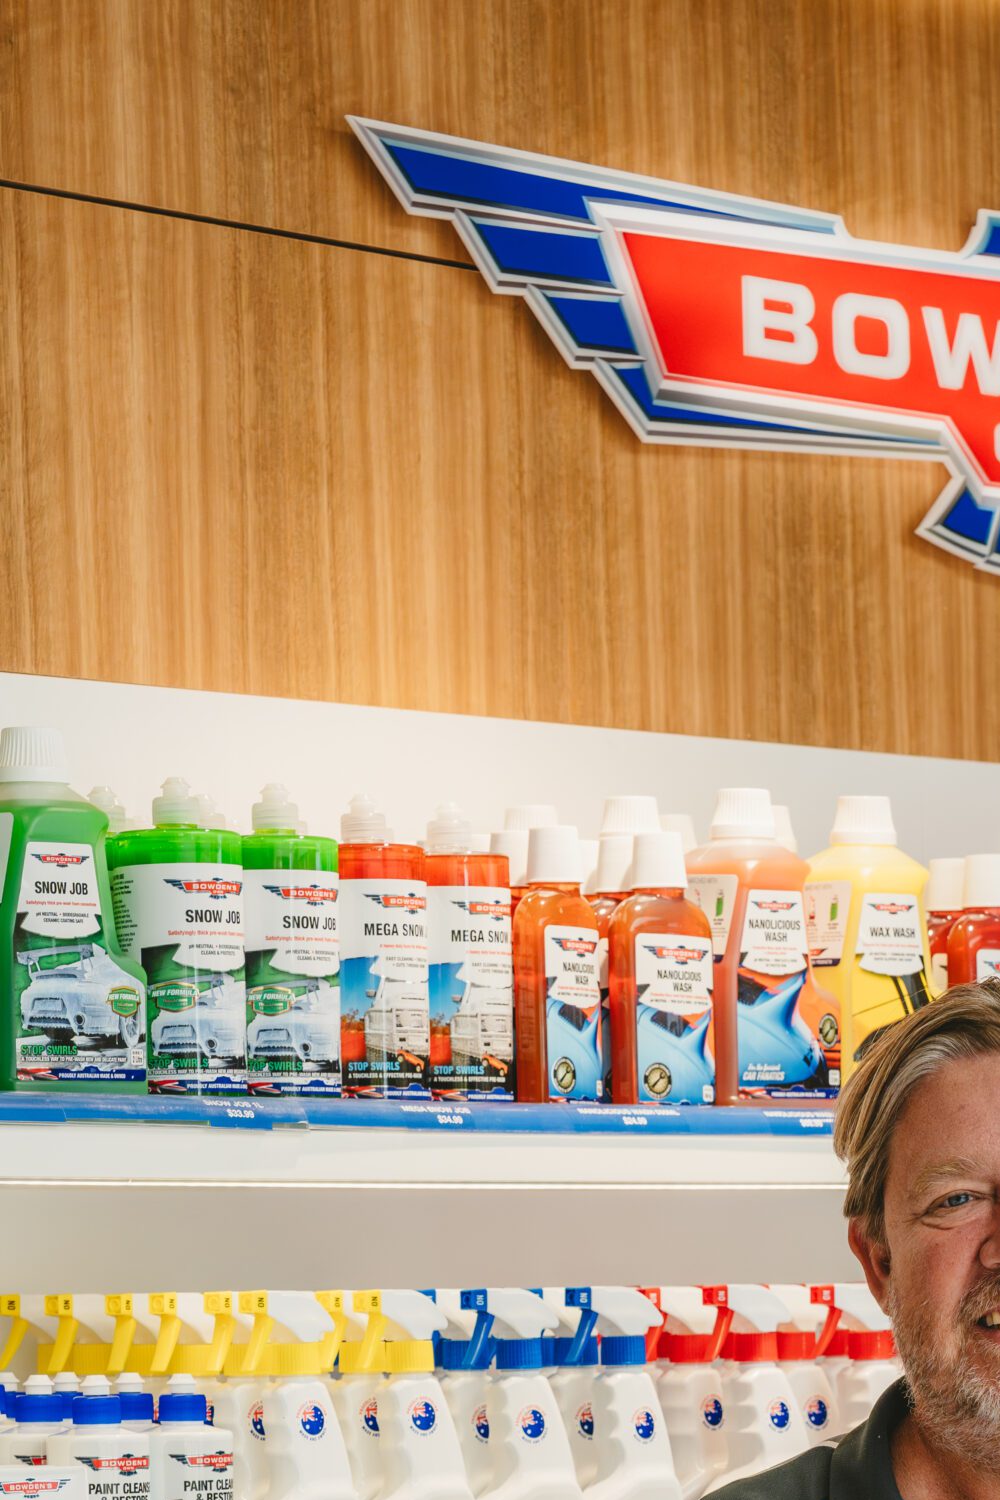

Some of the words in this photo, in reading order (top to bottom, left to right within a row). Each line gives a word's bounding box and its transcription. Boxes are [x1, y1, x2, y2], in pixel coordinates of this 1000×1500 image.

[35, 880, 67, 895] SNOW
[70, 882, 89, 897] JOB
[192, 883, 237, 891] BOWDEN'S
[185, 909, 222, 924] SNOW
[225, 910, 241, 924] JOB
[283, 915, 319, 930] SNOW
[322, 917, 337, 931] JOB
[364, 922, 399, 937] MEGA
[402, 923, 424, 938] SNOW
[749, 918, 801, 931] NANOLICIOUS
[451, 929, 485, 943] MEGA
[488, 930, 509, 943] SNOW
[765, 931, 788, 942] WASH
[870, 926, 890, 938] WAX
[893, 927, 916, 939] WASH
[657, 969, 702, 982] NANOLICIOUS
[151, 990, 166, 998] NEW
[167, 989, 199, 998] FORMULA
[673, 982, 693, 993] WASH
[21, 1044, 39, 1056] STOP
[46, 1044, 78, 1056] SWIRLS
[173, 1058, 209, 1069] SWIRLS
[348, 1061, 369, 1071] STOP
[375, 1061, 401, 1072] SWIRLS
[434, 1065, 454, 1075] STOP
[456, 1065, 485, 1075] SWIRLS
[476, 1293, 484, 1306] ON
[579, 1291, 587, 1304] ON
[101, 1458, 147, 1468] BOWDEN'S
[9, 1482, 53, 1491] BOWDEN'S
[89, 1483, 120, 1495] PAINT
[122, 1481, 150, 1495] CLEANS
[184, 1479, 212, 1491] PAINT
[214, 1478, 233, 1491] CLEA
